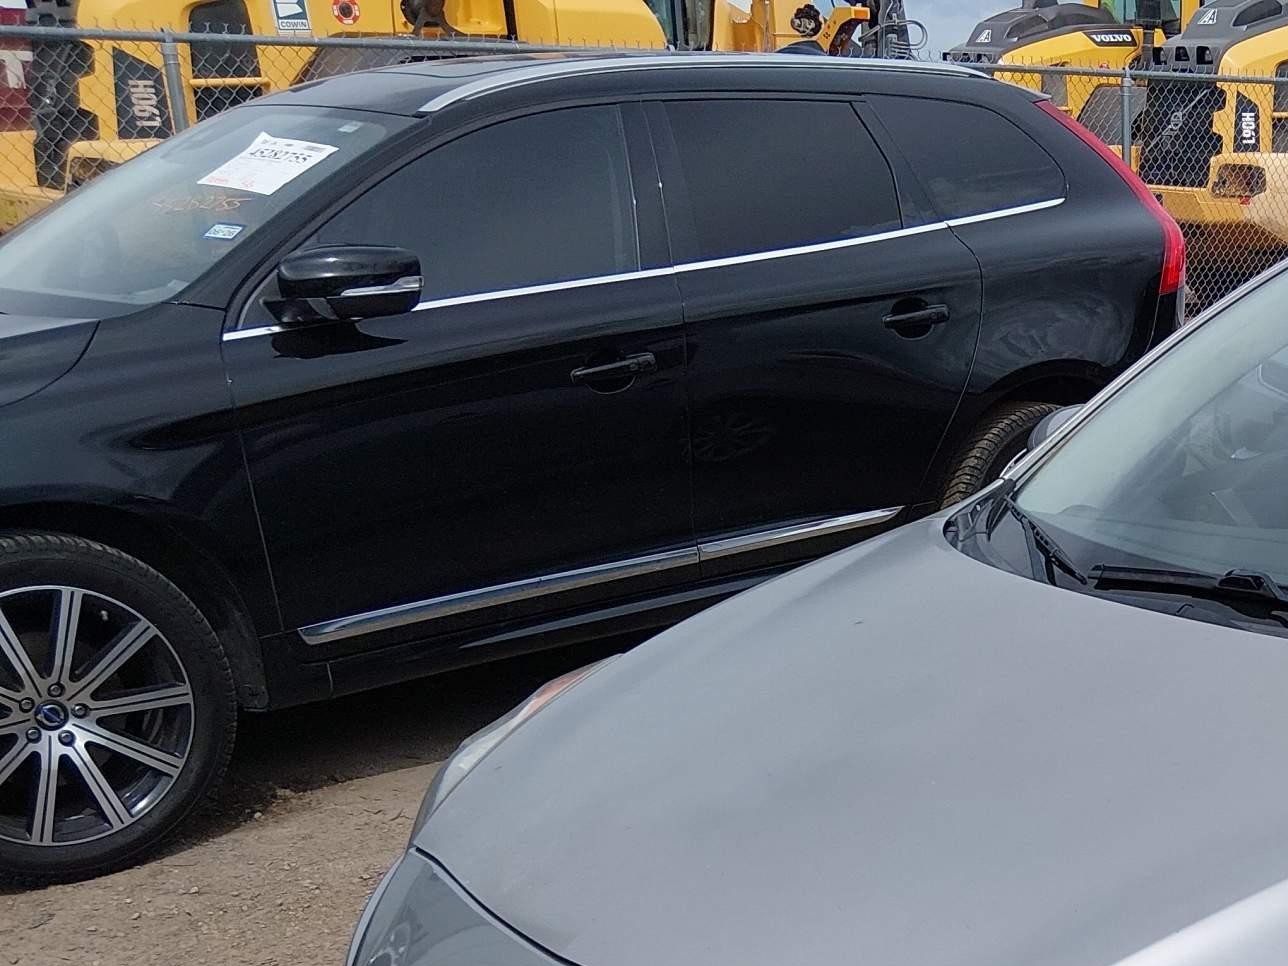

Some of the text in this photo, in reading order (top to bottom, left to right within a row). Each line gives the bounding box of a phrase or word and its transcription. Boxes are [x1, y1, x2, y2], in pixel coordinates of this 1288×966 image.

[1090, 34, 1132, 42] VOLVO
[128, 79, 162, 127] L90H
[1241, 112, 1256, 144] L90H
